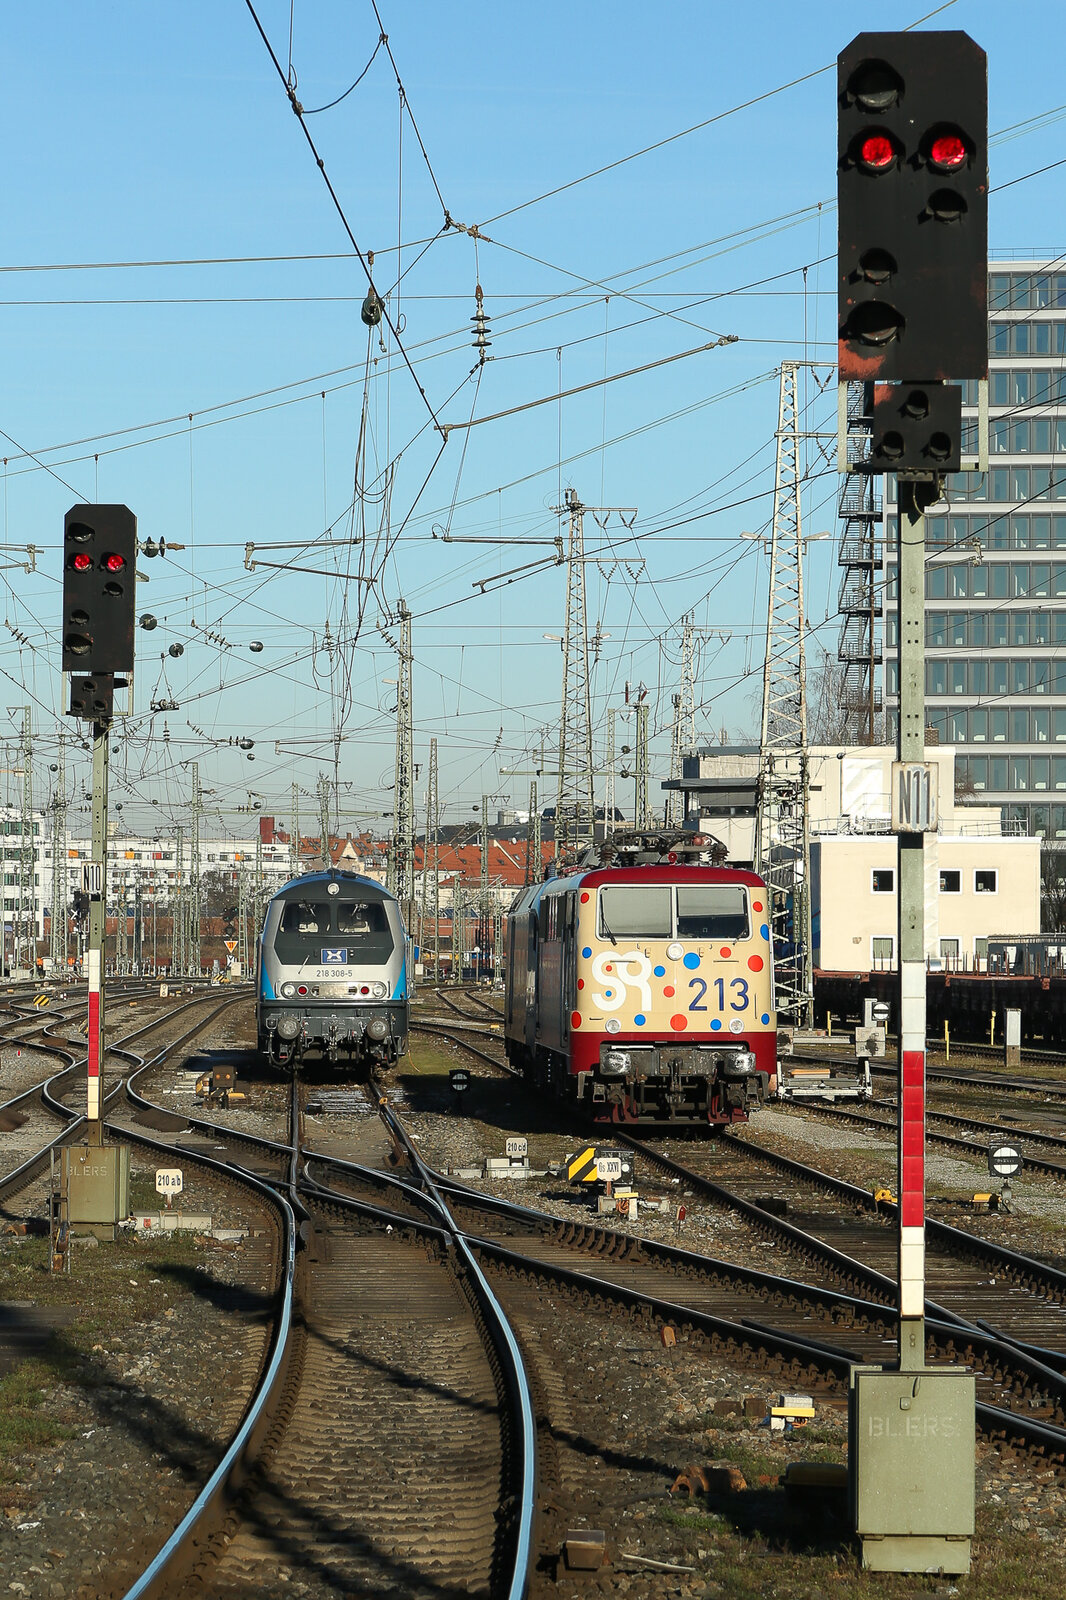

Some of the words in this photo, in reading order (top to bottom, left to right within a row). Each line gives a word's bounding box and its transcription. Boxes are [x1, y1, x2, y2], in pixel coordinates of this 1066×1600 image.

[899, 770, 930, 824] N11
[84, 865, 100, 891] N10
[316, 969, 330, 978] 218
[330, 969, 353, 978] 308-5
[688, 977, 749, 1011] 213
[507, 1142, 518, 1152] 210
[157, 1174, 170, 1186] 210
